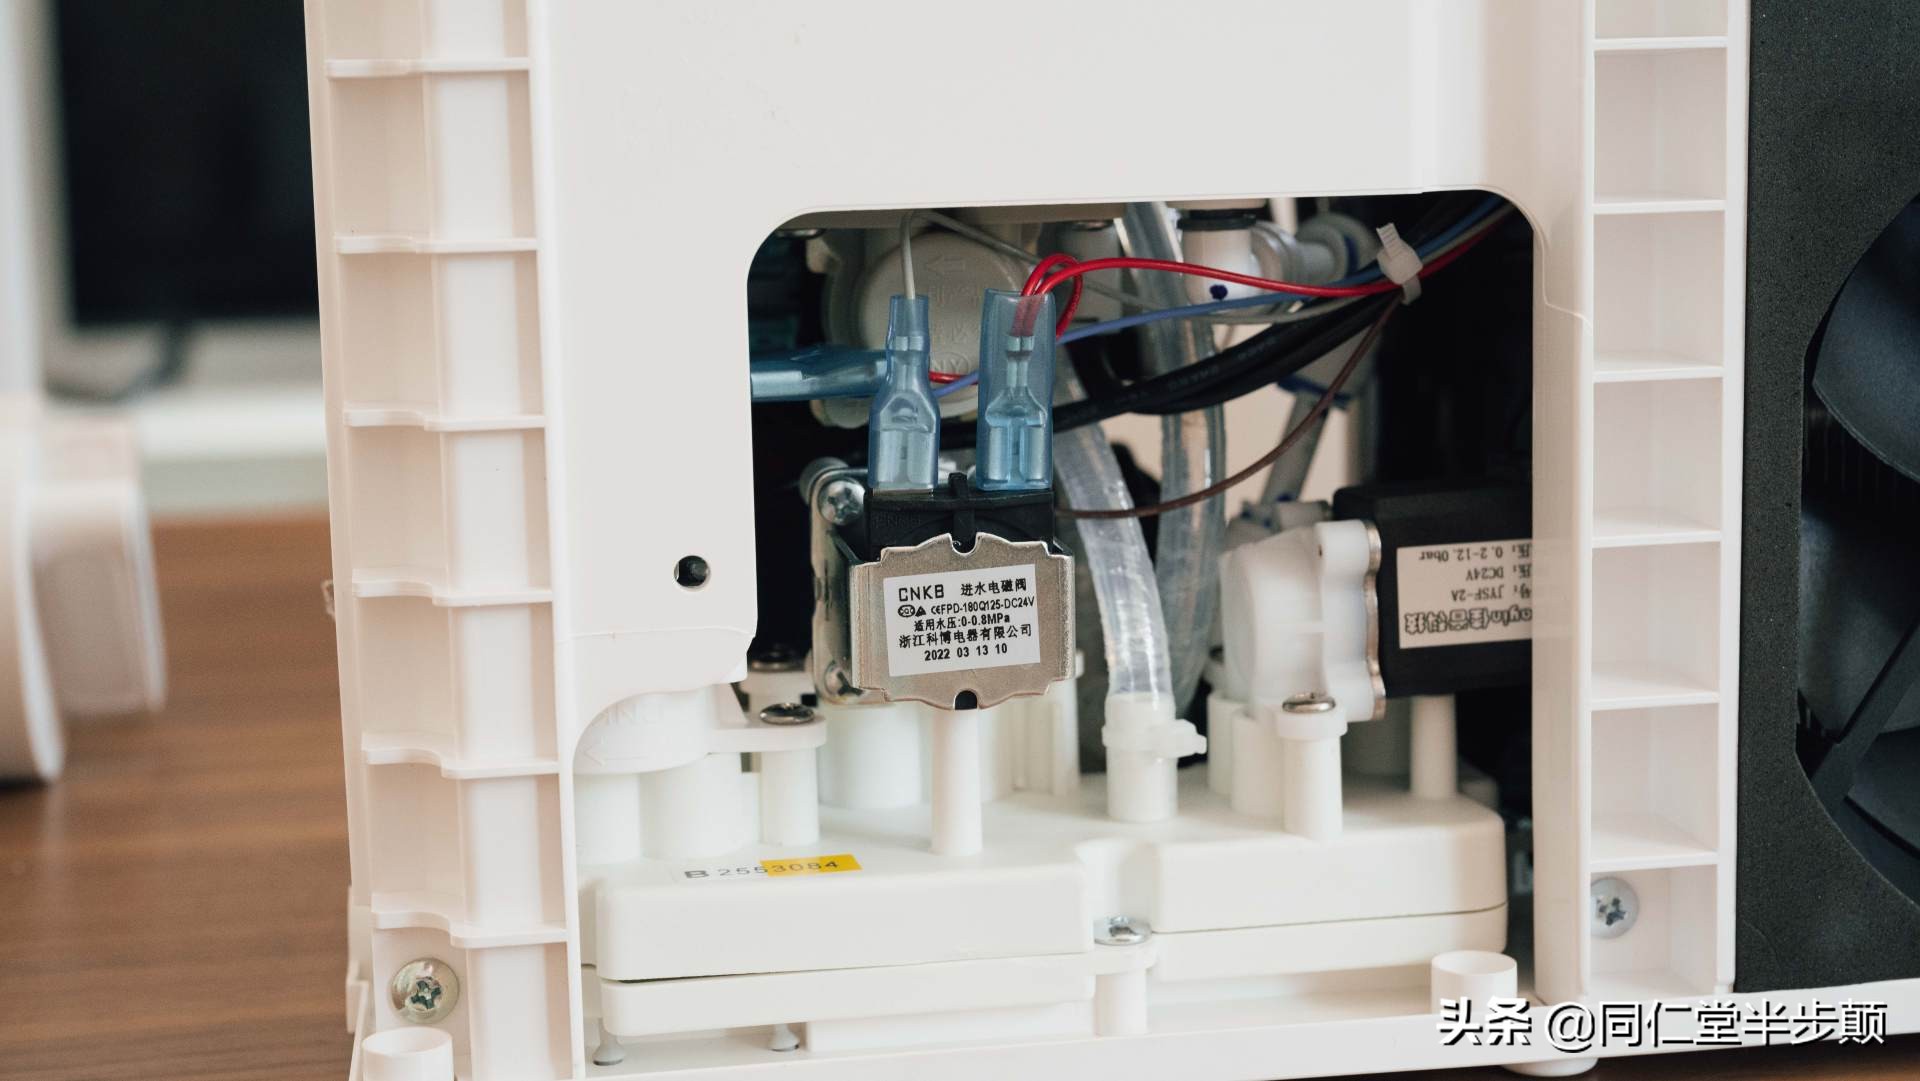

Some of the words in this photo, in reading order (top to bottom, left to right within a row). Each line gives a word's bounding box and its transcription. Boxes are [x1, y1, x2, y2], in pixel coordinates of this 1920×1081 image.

[1466, 567, 1504, 581] DC24V
[898, 584, 945, 602] CNKB
[960, 578, 1027, 597] 进水电磁阀
[1451, 584, 1504, 602] JYSF-2A
[899, 623, 1032, 649] 浙江科博电器有限公司
[924, 649, 950, 662] 2022
[957, 647, 969, 658] 03
[976, 645, 989, 656] 13
[995, 643, 1008, 654] 10
